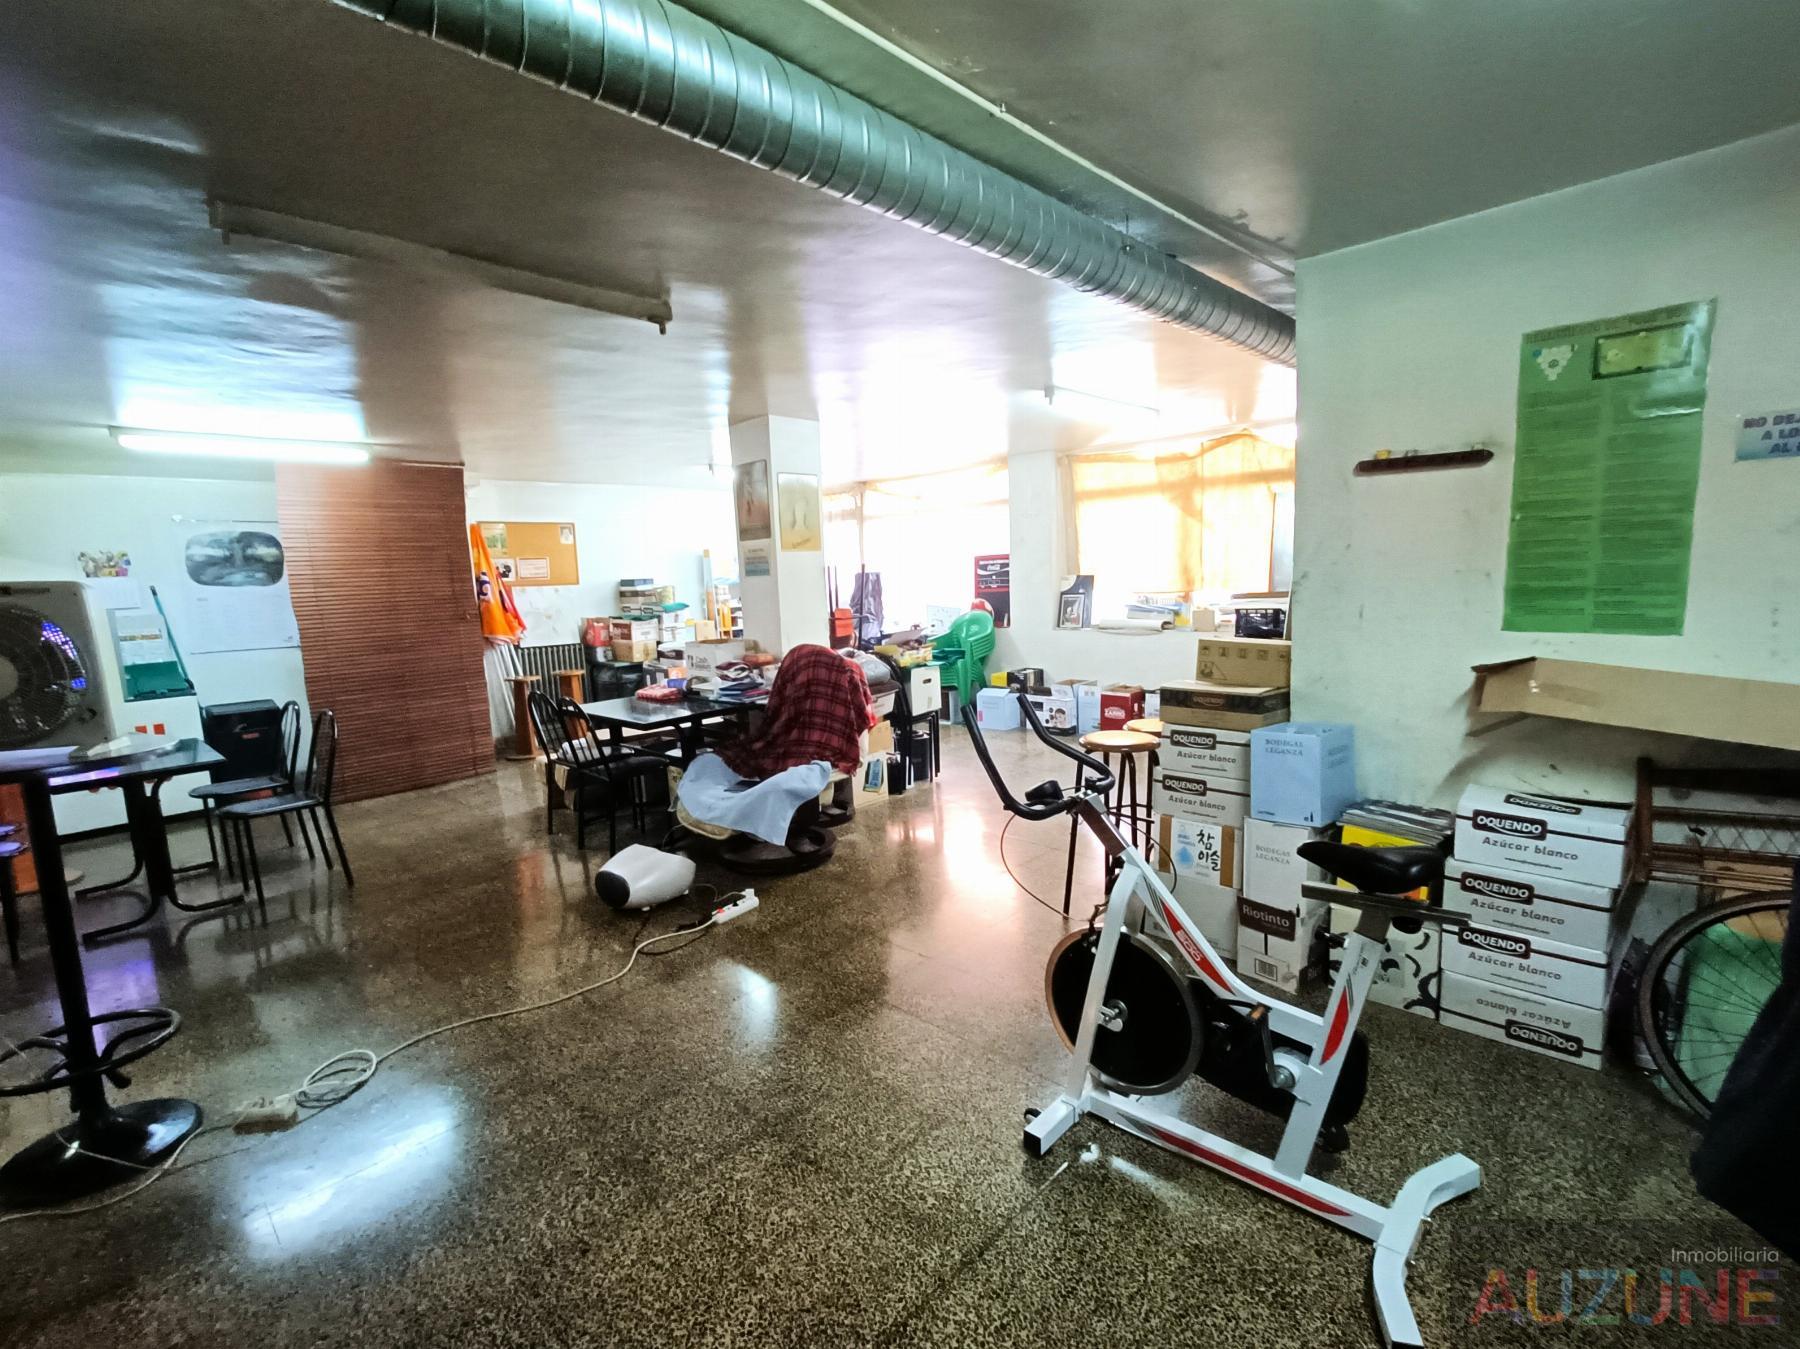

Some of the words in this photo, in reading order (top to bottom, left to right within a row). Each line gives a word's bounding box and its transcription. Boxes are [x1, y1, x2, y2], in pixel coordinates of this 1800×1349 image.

[1761, 430, 1772, 441] A
[1173, 734, 1213, 747] OQUENDO
[1177, 750, 1206, 761] Azúcar
[1209, 752, 1237, 764] blanco
[1165, 778, 1204, 793] OQUENDO
[1168, 795, 1197, 806] Azúcar
[1199, 800, 1226, 811] blanco
[1477, 815, 1542, 836] OQUENDO
[1482, 836, 1530, 852] Azúcar
[1534, 845, 1578, 861] blanco
[1465, 877, 1529, 898] OQUENDO
[1242, 904, 1290, 927] Riotinto
[1470, 898, 1517, 915] Azúcar
[1521, 908, 1565, 925] blanco
[1462, 931, 1526, 953] OQUENDO
[1468, 951, 1515, 969] Azúcar
[1518, 962, 1562, 980] blanco
[1476, 997, 1517, 1016] blanco
[1510, 1025, 1577, 1051] OQUENDO
